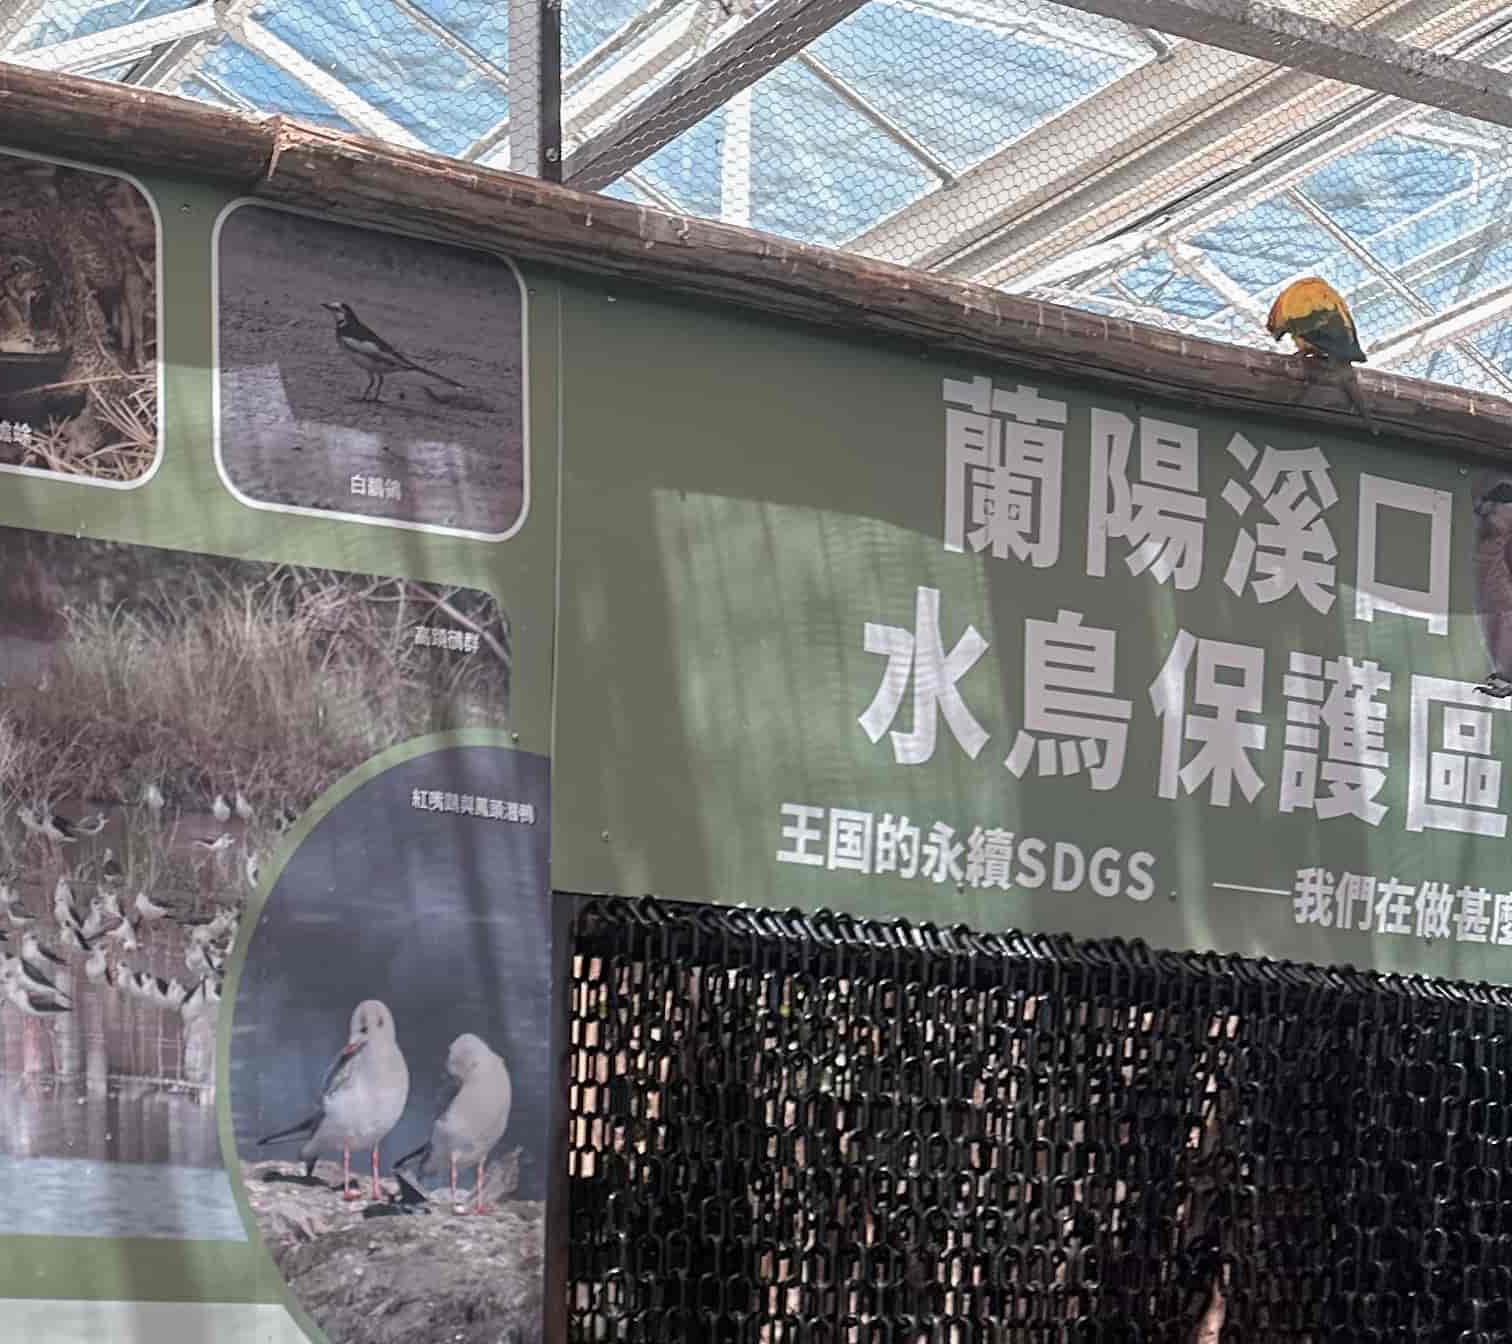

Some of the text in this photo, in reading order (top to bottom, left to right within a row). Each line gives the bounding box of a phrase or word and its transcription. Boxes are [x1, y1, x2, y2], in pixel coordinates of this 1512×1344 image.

[942, 377, 1453, 636] 蘭陽溪口
[858, 586, 1510, 838] 水鳥保護區
